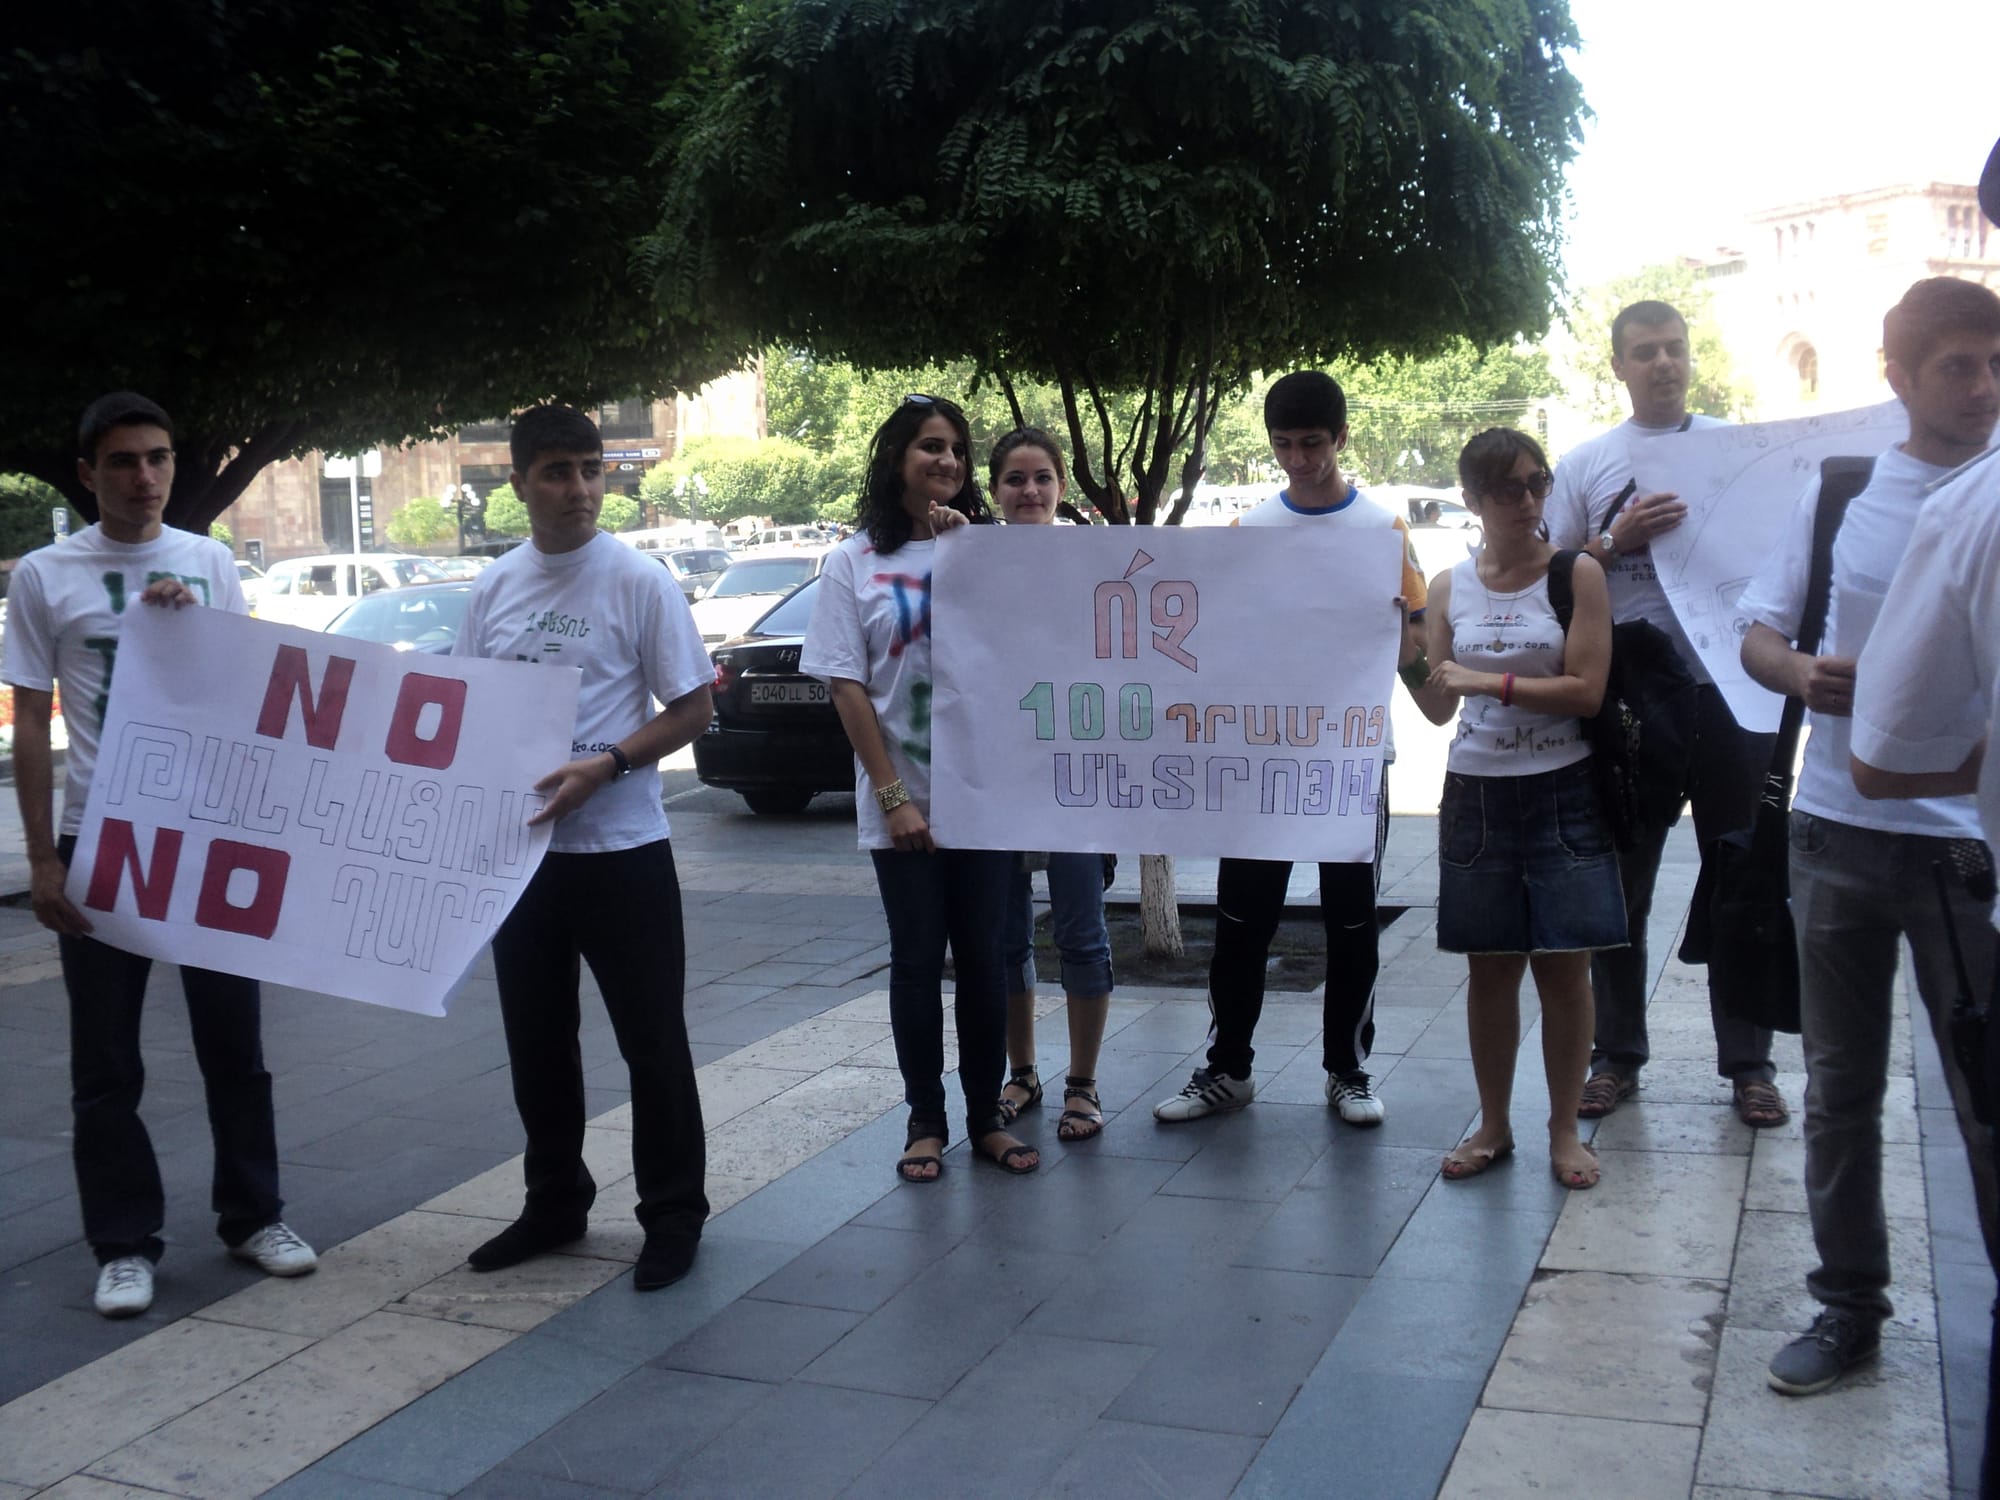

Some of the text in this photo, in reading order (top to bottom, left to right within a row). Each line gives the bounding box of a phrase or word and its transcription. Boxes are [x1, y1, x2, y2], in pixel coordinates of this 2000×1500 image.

[256, 643, 467, 771] NO
[761, 684, 786, 701] 040
[788, 687, 802, 701] LL
[808, 684, 826, 701] 50
[1019, 681, 1154, 741] 100
[84, 816, 292, 940] NO
